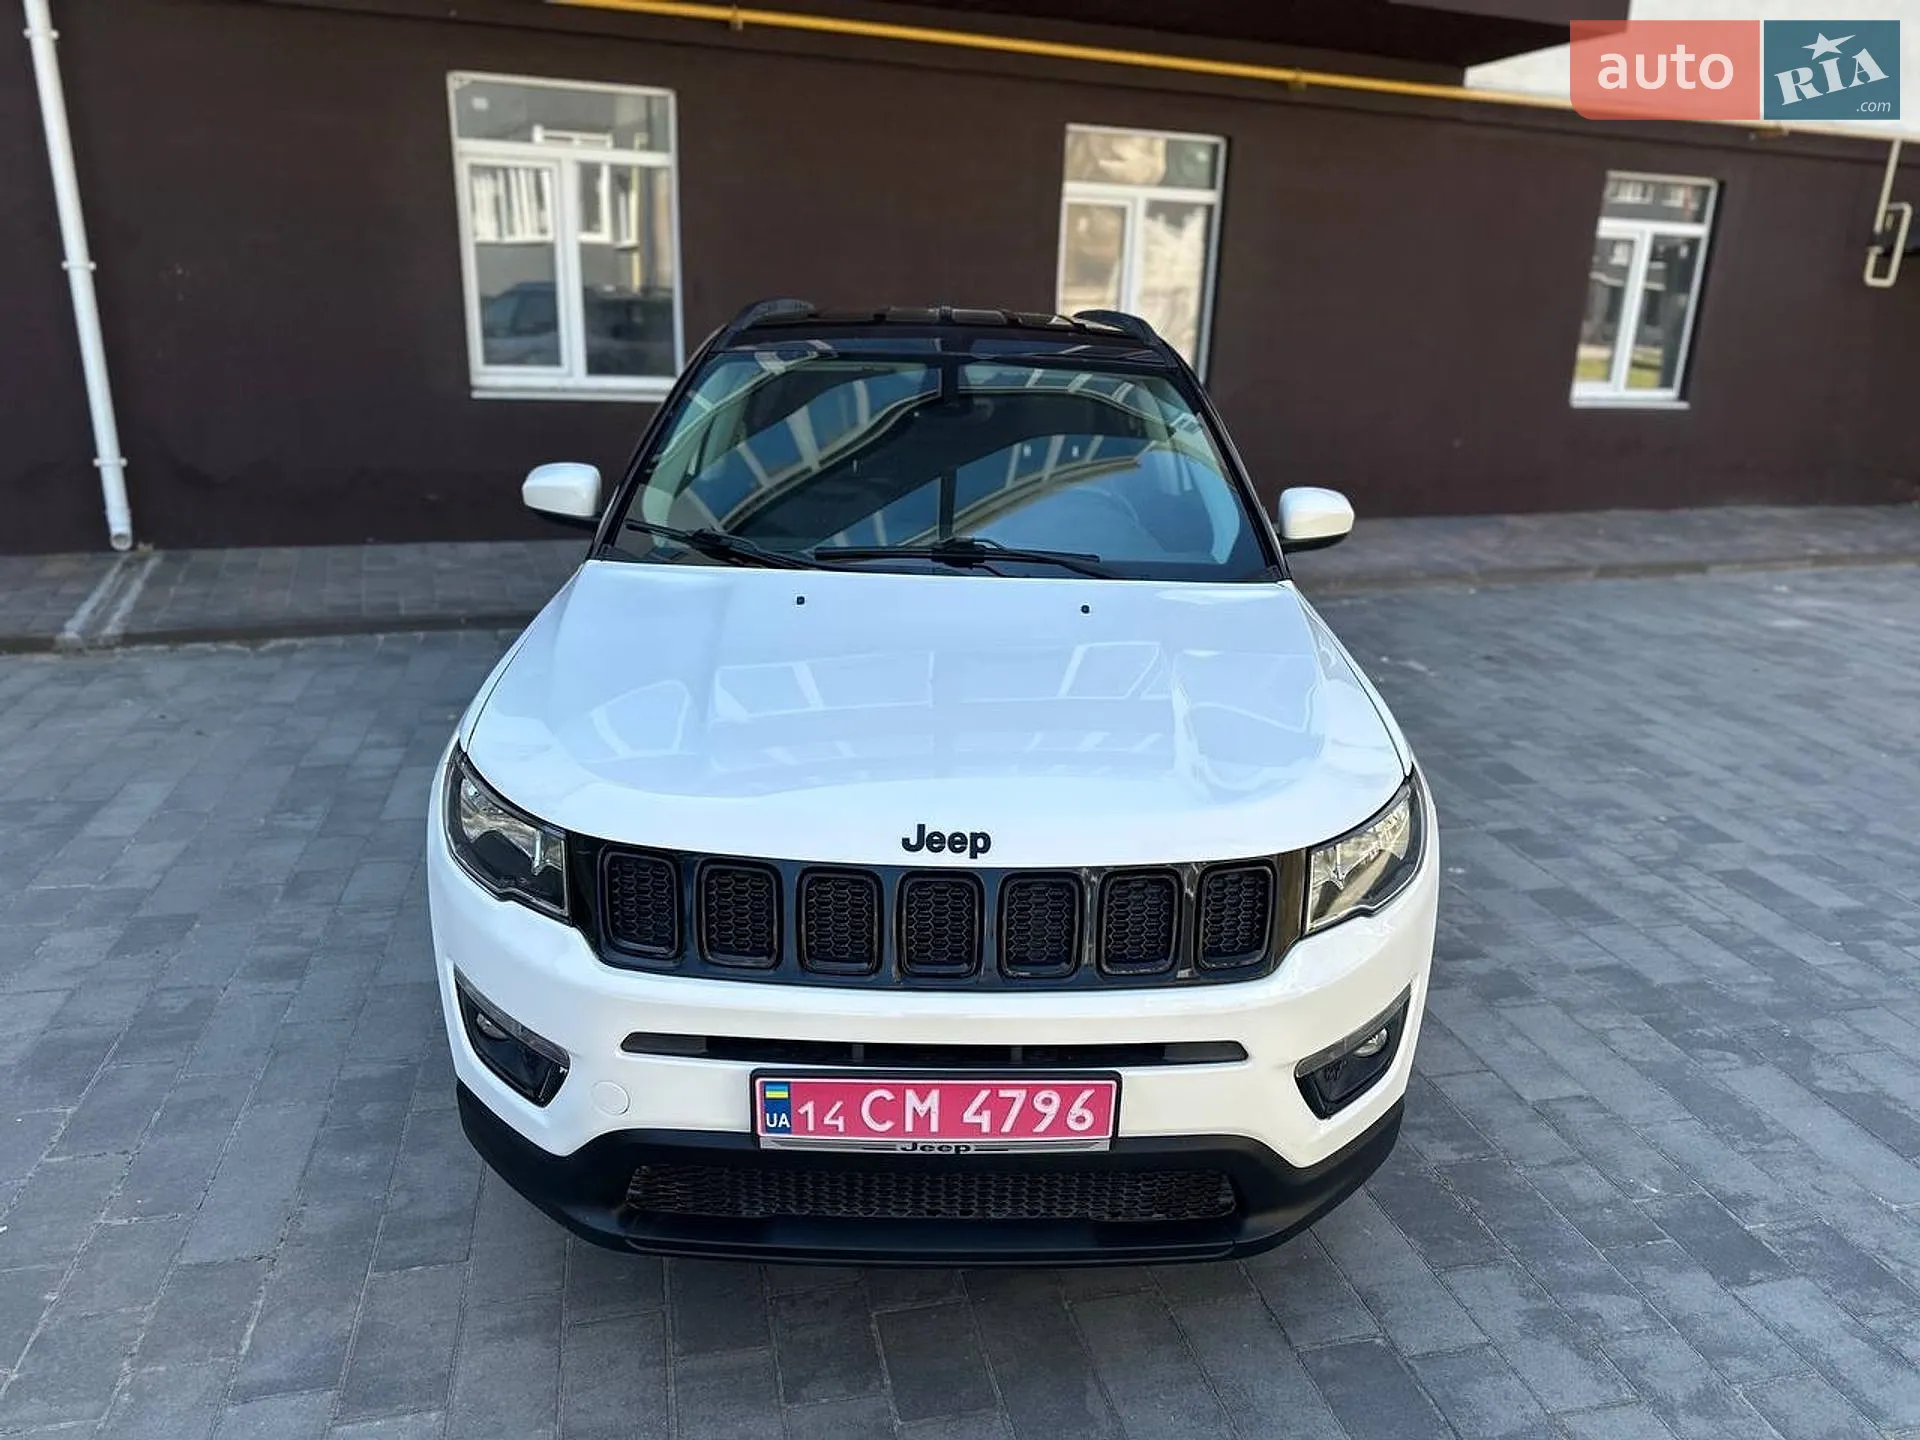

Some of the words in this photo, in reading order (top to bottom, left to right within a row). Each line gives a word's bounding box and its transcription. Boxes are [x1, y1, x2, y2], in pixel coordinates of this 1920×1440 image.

[902, 823, 991, 859] Jeep
[766, 1113, 790, 1128] UA
[797, 1101, 844, 1132] 14
[861, 1088, 939, 1132] CM
[962, 1089, 1095, 1132] 4796
[900, 1141, 971, 1154] Jeep
